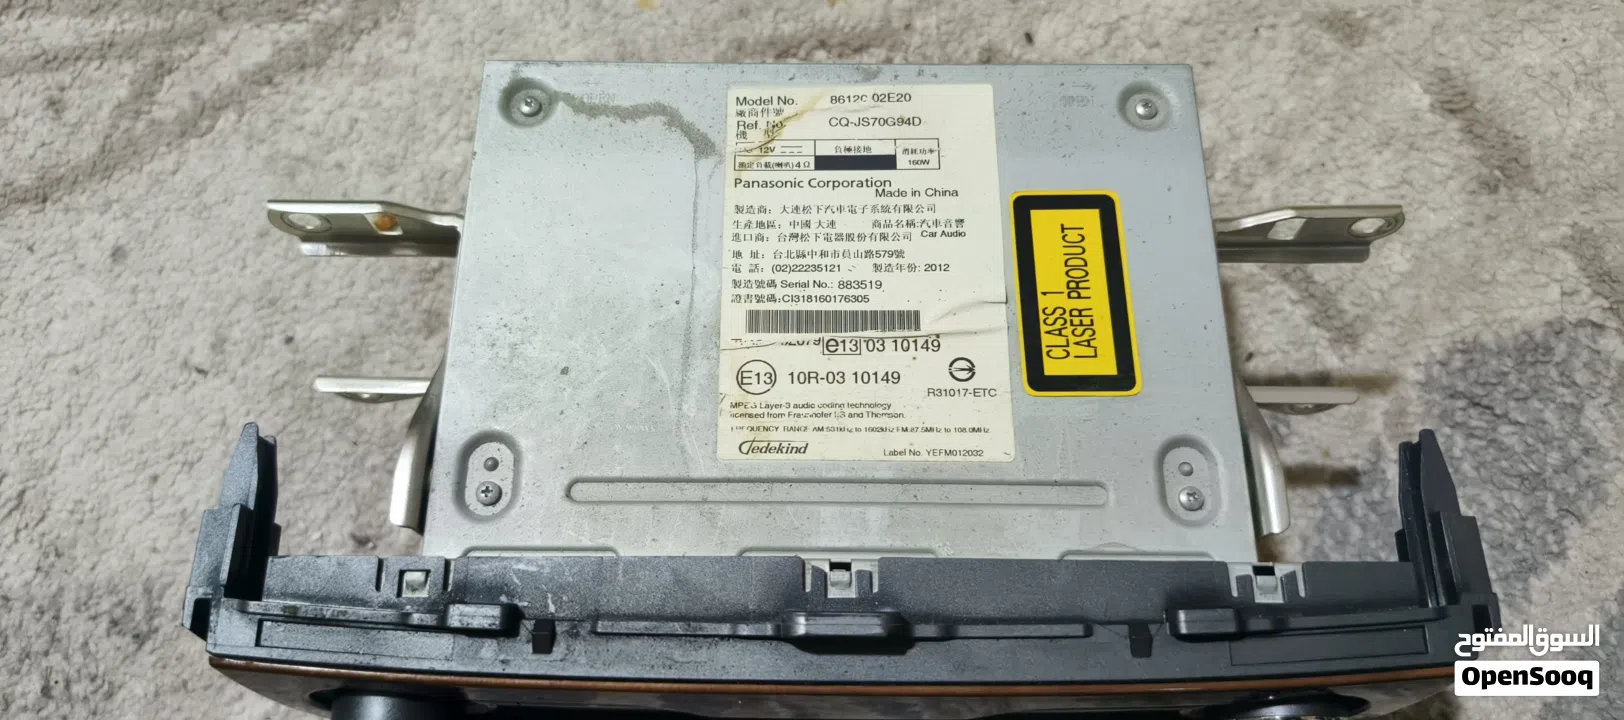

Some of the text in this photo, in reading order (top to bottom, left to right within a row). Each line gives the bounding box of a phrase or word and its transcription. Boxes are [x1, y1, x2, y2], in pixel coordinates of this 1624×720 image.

[735, 95, 799, 106] Model No.
[736, 120, 762, 130] Ref.
[828, 116, 923, 128] CQ-JS70G94D
[759, 146, 776, 154] 12V
[734, 177, 892, 191] Panasonic Corporation
[875, 187, 959, 198] Made in China
[780, 203, 937, 215] 大連松下汽車電子系統有限公司
[788, 220, 812, 230] 中國
[815, 220, 837, 230] 大連
[777, 231, 913, 243] 台灣松下電器股份有限公司
[920, 230, 966, 238] Car Audio
[771, 263, 842, 275] (02)22235121
[924, 263, 950, 272] 2012
[780, 280, 810, 289] Serial
[812, 280, 834, 289] No.:
[837, 280, 883, 290] 883519
[1060, 223, 1098, 359] LASER PRODUCT
[1042, 306, 1070, 360] CLASS
[825, 338, 859, 353] e13
[892, 338, 941, 353] 10149
[740, 370, 773, 386] E13
[787, 370, 901, 385] 10R-03 10149
[927, 387, 997, 398] R31017-ETC
[759, 401, 791, 411] Layer-3
[847, 402, 892, 411] technology
[883, 448, 984, 457] Label No. YEFM012032
